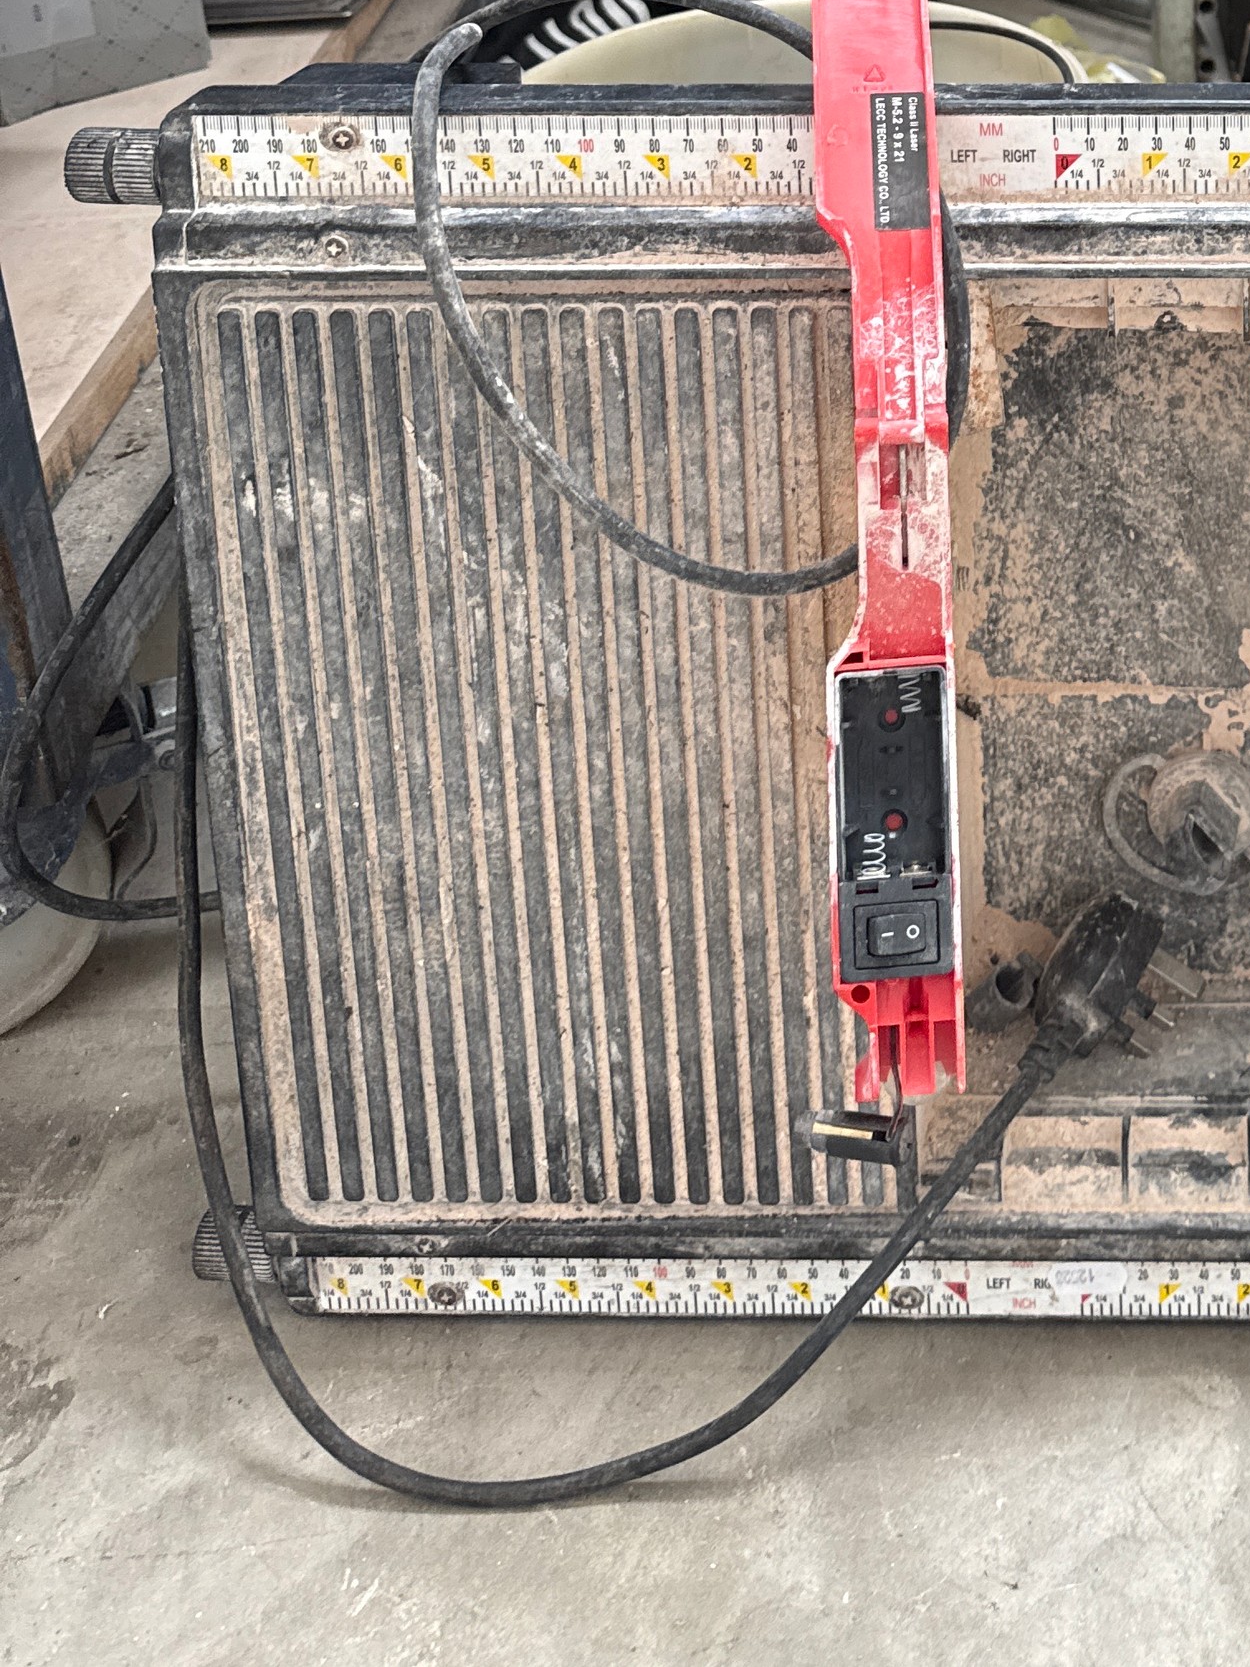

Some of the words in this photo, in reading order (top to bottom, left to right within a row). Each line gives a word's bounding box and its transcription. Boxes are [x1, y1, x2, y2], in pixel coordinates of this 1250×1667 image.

[875, 97, 886, 121] LECC
[908, 96, 919, 120] Class
[979, 123, 1003, 136] MM
[200, 140, 215, 153] 210
[232, 140, 249, 153] 200
[267, 140, 283, 153] 190
[301, 140, 318, 153] 180
[371, 139, 387, 153] 160
[440, 139, 455, 153] 140
[475, 139, 490, 153] 130
[508, 139, 524, 153] 120
[544, 139, 561, 153] 110
[578, 139, 594, 153] 100
[614, 139, 625, 153] 90
[649, 139, 660, 153] 80
[683, 139, 694, 153] 70
[717, 139, 728, 152] 60
[752, 139, 763, 152] 50
[787, 139, 797, 152] 40
[909, 128, 919, 152] Laser
[1054, 138, 1059, 151] 0
[1085, 137, 1095, 151] 10
[1118, 137, 1128, 151] 20
[1152, 137, 1162, 151] 30
[1185, 137, 1196, 150] 40
[1219, 137, 1230, 150] 50
[876, 122, 889, 184] TECHNOLOGY
[894, 150, 905, 163] 21
[951, 149, 977, 163] LEFT
[1003, 149, 1036, 163] RIGHT
[220, 158, 228, 171] 8
[306, 158, 314, 171] 7
[394, 158, 402, 171] 6
[482, 158, 490, 171] 5
[569, 158, 577, 170] 4
[657, 158, 665, 170] 3
[744, 158, 752, 170] 2
[267, 161, 280, 170] 1/2
[442, 160, 456, 170] 1/2
[530, 160, 543, 169] 1/2
[618, 160, 631, 169] 1/2
[792, 160, 805, 169] 1/2
[1061, 156, 1069, 169] 0
[1146, 156, 1152, 169] 1
[1232, 156, 1240, 168] 2
[1091, 159, 1105, 167] 1/2
[1178, 158, 1191, 167] 1/2
[979, 174, 1006, 186] INCH
[349, 1264, 363, 1275] 200
[379, 1263, 394, 1275] 190
[410, 1264, 424, 1276] 180
[441, 1264, 455, 1276] 170
[501, 1265, 515, 1277] 150
[531, 1266, 545, 1277] 140
[562, 1266, 576, 1277] 130
[624, 1266, 639, 1278] 110
[652, 1266, 668, 1278] 100
[685, 1267, 696, 1278] 90
[716, 1267, 727, 1279] 80
[747, 1267, 757, 1279] 70
[777, 1267, 788, 1279] 60
[808, 1267, 818, 1279] 50
[838, 1267, 849, 1279] 40
[900, 1267, 911, 1279] 20
[932, 1268, 941, 1279] 10
[965, 1269, 970, 1280] 0
[1138, 1269, 1148, 1280] 20
[1169, 1269, 1179, 1280] 30
[1199, 1269, 1209, 1280] 40
[1231, 1269, 1241, 1280] 50
[337, 1278, 345, 1289] 8
[414, 1279, 422, 1290] 7
[491, 1280, 499, 1291] 6
[569, 1281, 577, 1291] 5
[645, 1282, 653, 1292] 4
[723, 1283, 731, 1293] 3
[800, 1283, 808, 1293] 2
[986, 1278, 1010, 1289] LEFT
[1034, 1278, 1050, 1289] RIG
[1243, 1285, 1250, 1295] 2
